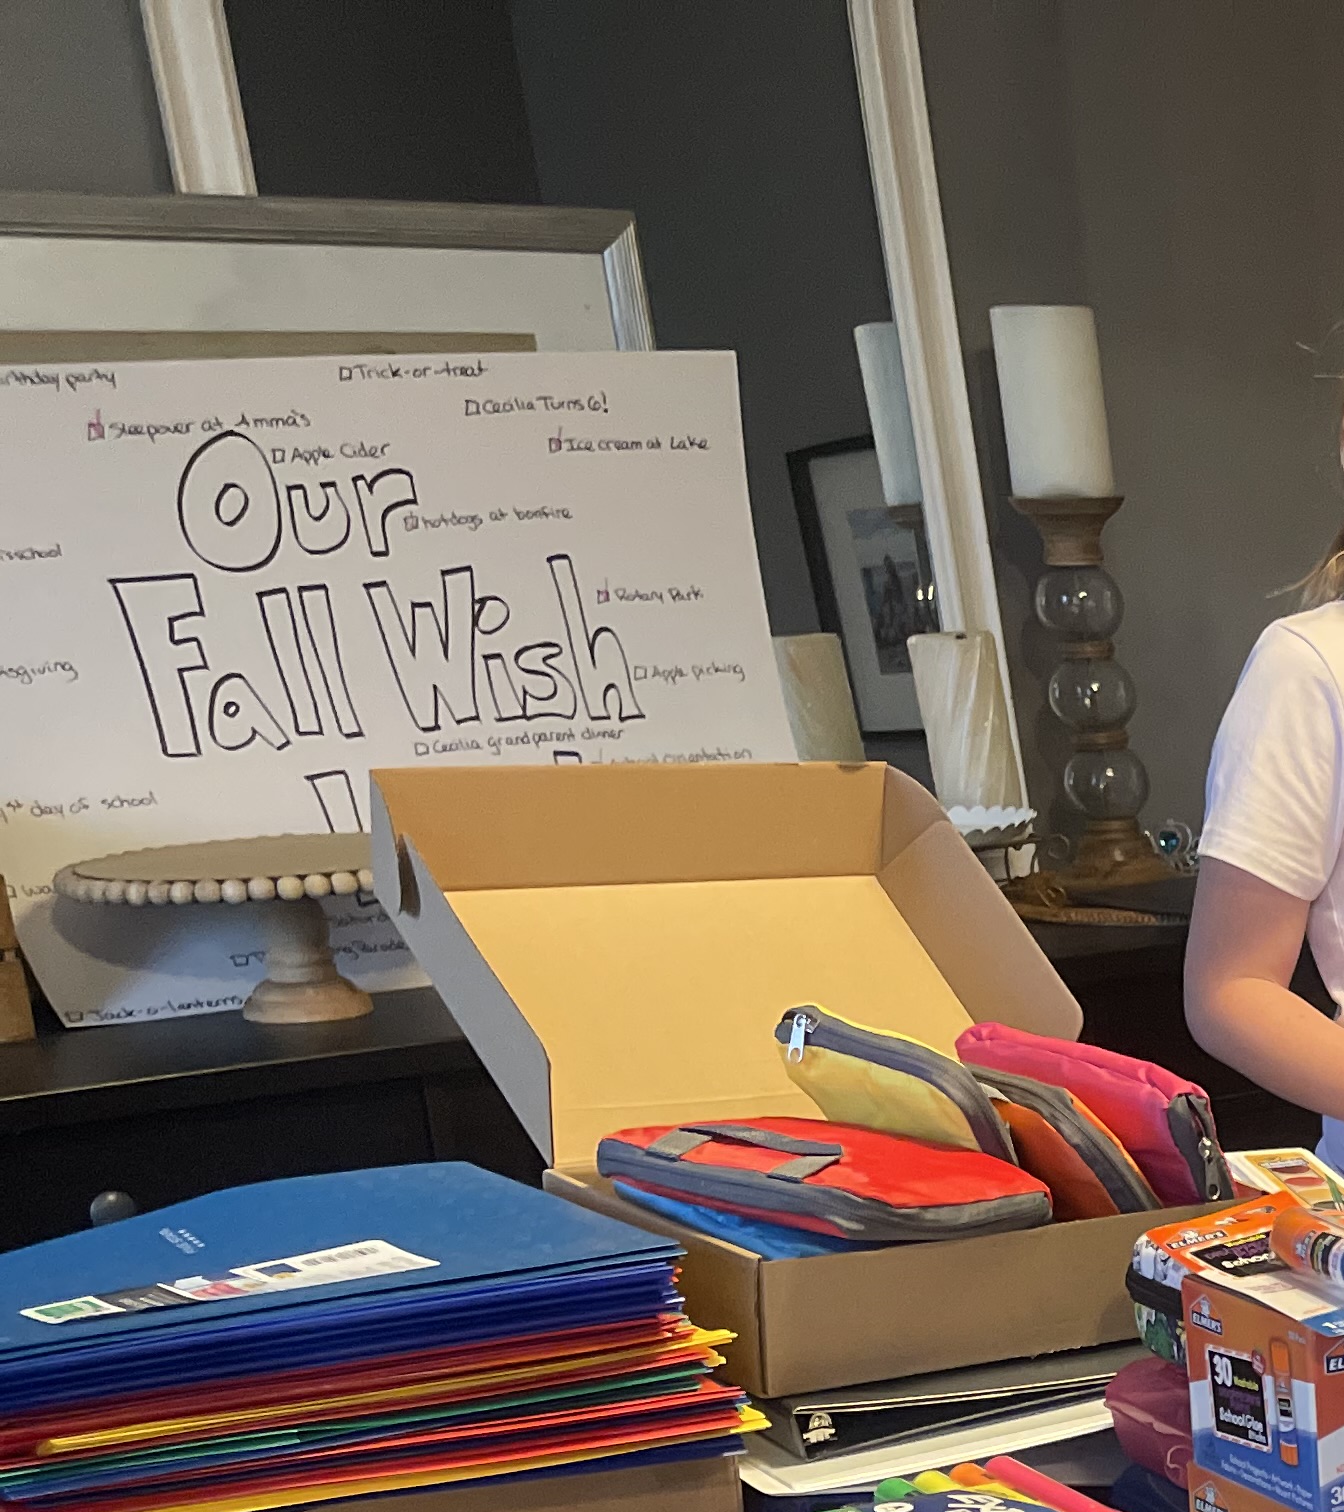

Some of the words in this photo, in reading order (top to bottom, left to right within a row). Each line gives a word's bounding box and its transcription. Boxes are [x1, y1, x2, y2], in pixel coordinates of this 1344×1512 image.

[201, 415, 222, 431] at
[670, 436, 711, 451] Lake
[177, 430, 419, 573] Our
[107, 573, 366, 758] Fall
[362, 553, 646, 733] Wish
[1212, 1354, 1234, 1388] 30
